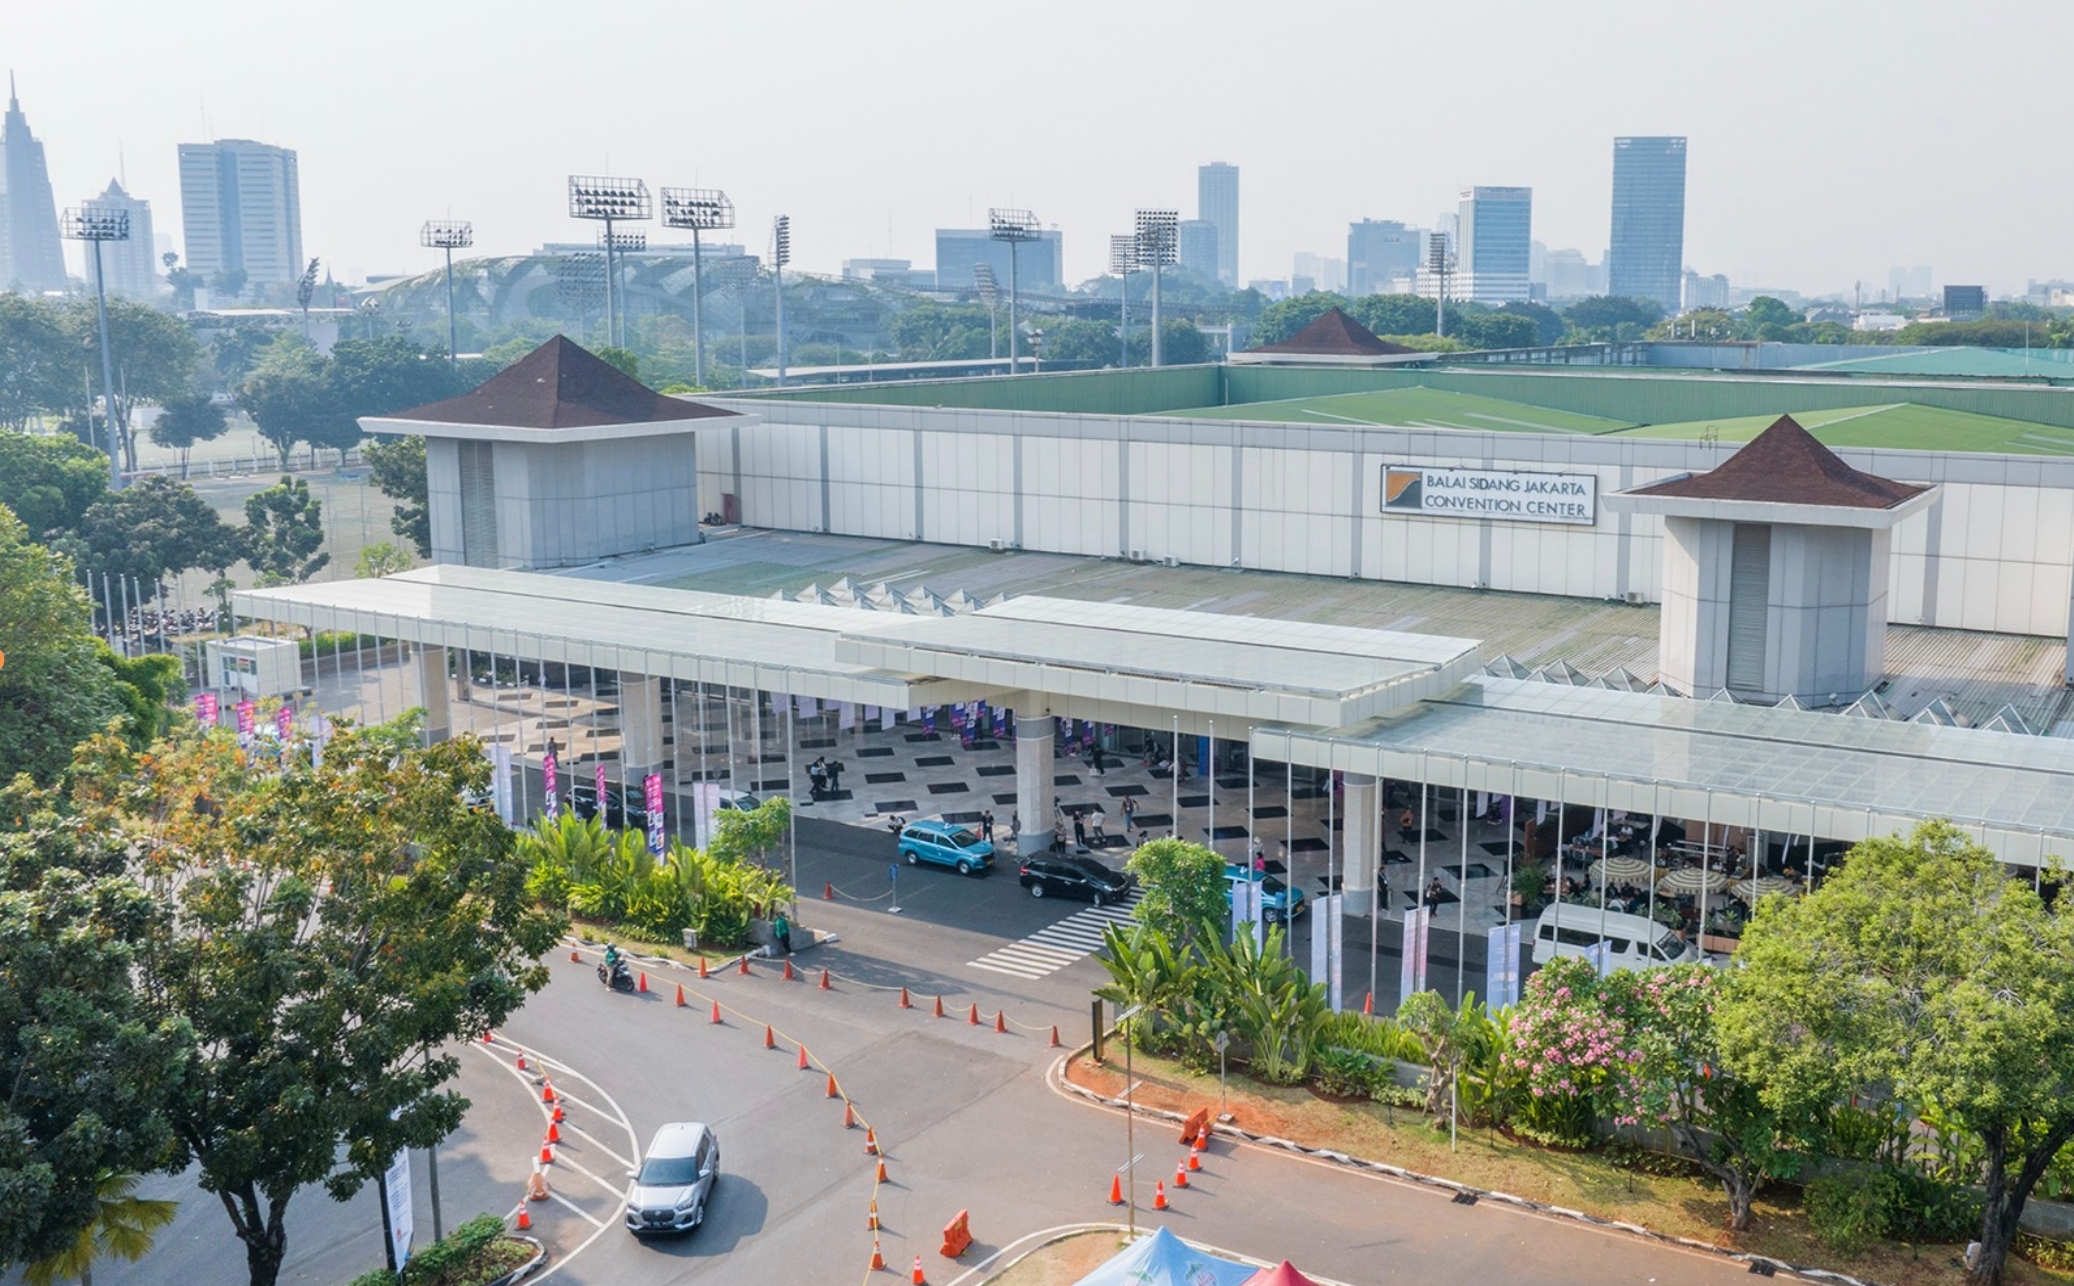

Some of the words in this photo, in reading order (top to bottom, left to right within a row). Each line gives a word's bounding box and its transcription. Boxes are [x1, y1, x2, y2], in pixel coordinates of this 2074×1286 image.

[1427, 475, 1466, 489] BALAI
[1469, 477, 1521, 492] SIDANG
[1523, 480, 1586, 496] JAKARTA
[1425, 495, 1521, 512] CONVENTION
[1526, 501, 1586, 516] CENTER
